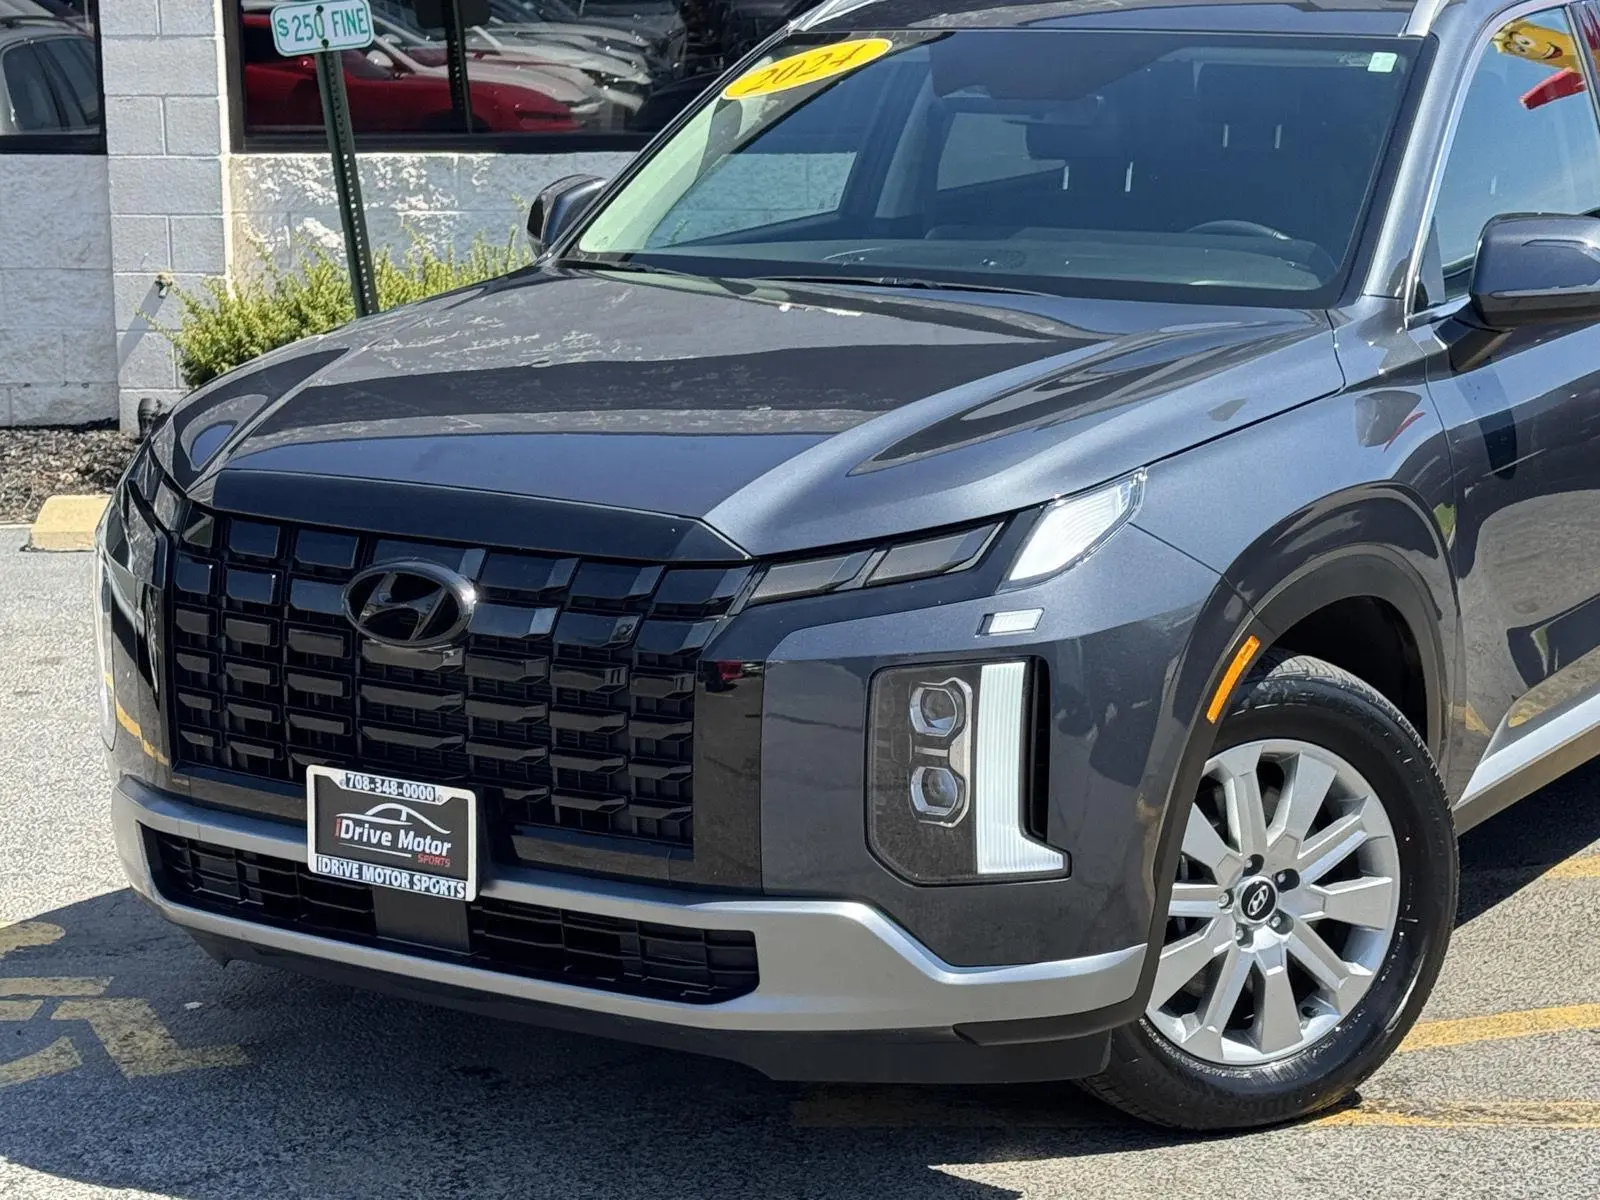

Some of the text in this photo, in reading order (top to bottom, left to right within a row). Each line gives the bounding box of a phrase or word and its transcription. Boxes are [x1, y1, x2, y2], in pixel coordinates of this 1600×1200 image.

[277, 8, 368, 42] $250 FINE
[744, 43, 867, 94] 2024
[347, 773, 435, 801] 708-348-0000
[334, 817, 452, 856] iDrive Motor
[417, 853, 451, 868] SPORTS
[362, 864, 410, 889] MOTOR
[413, 875, 465, 899] SPORTS
